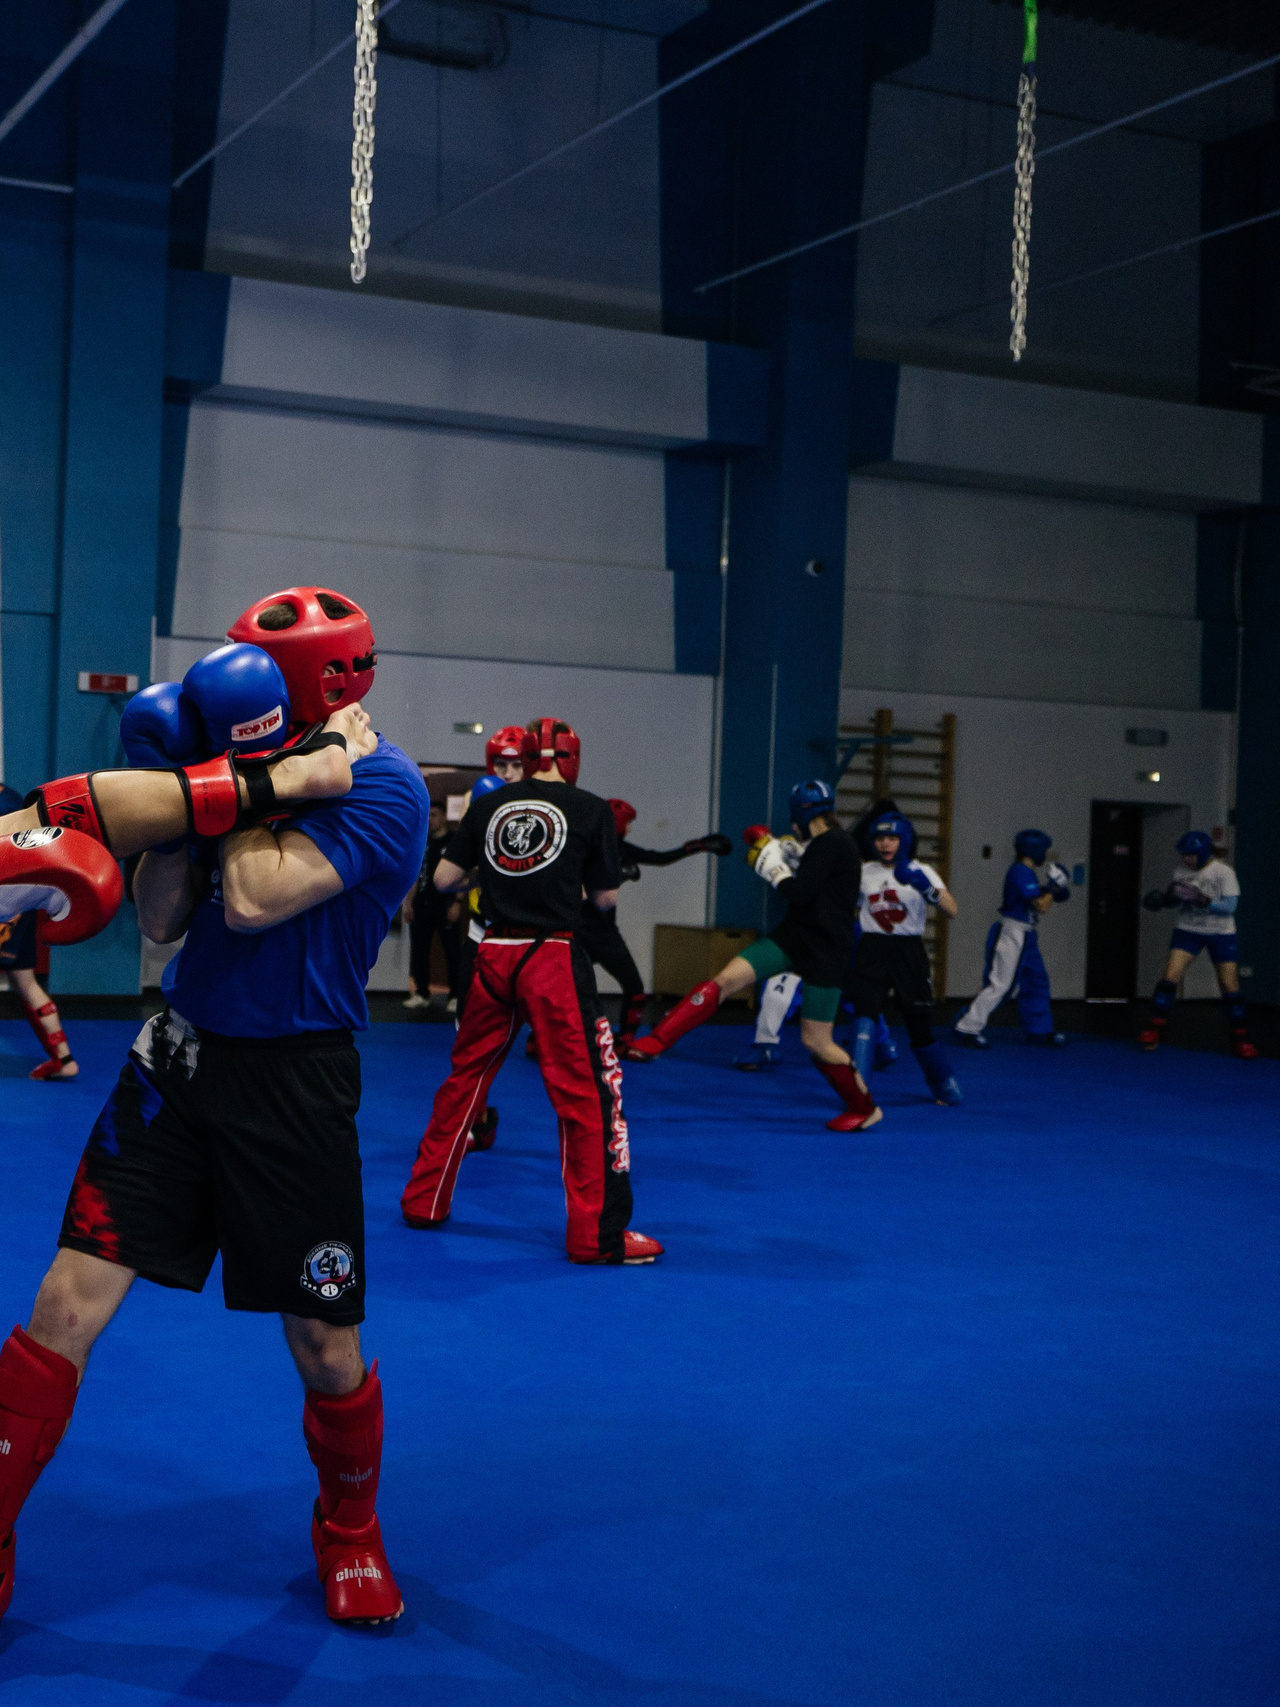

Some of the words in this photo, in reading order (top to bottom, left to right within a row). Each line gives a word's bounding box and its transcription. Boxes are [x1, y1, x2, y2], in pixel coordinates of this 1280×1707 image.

[237, 724, 261, 737] TOP
[261, 712, 280, 730] TEN
[335, 1566, 383, 1582] clinch
